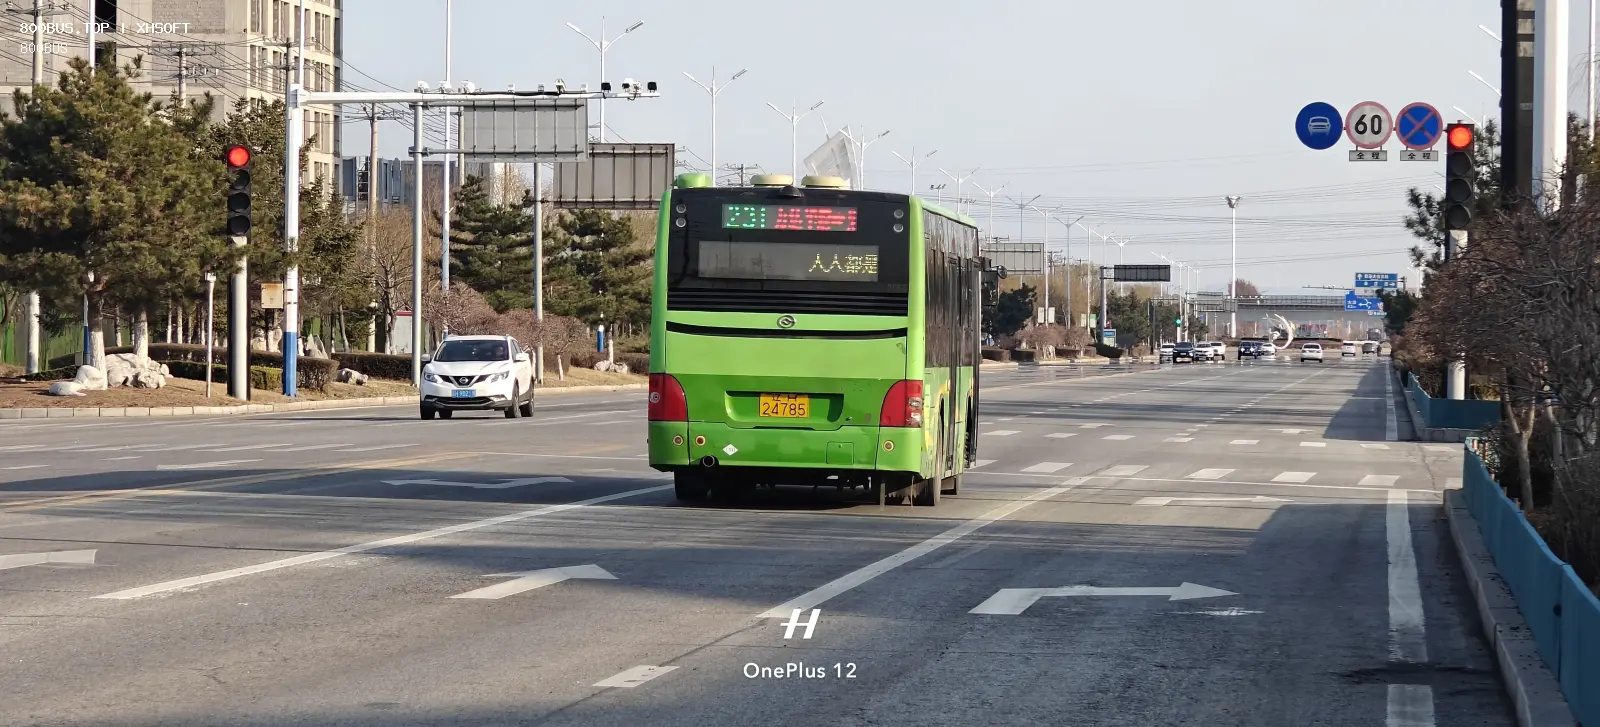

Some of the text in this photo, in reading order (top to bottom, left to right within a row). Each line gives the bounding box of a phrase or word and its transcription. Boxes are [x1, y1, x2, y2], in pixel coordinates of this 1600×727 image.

[1354, 114, 1382, 135] 60
[1356, 152, 1380, 160] 全程
[1407, 152, 1431, 160] 全程
[726, 206, 766, 228] 231
[762, 402, 806, 416] 24785
